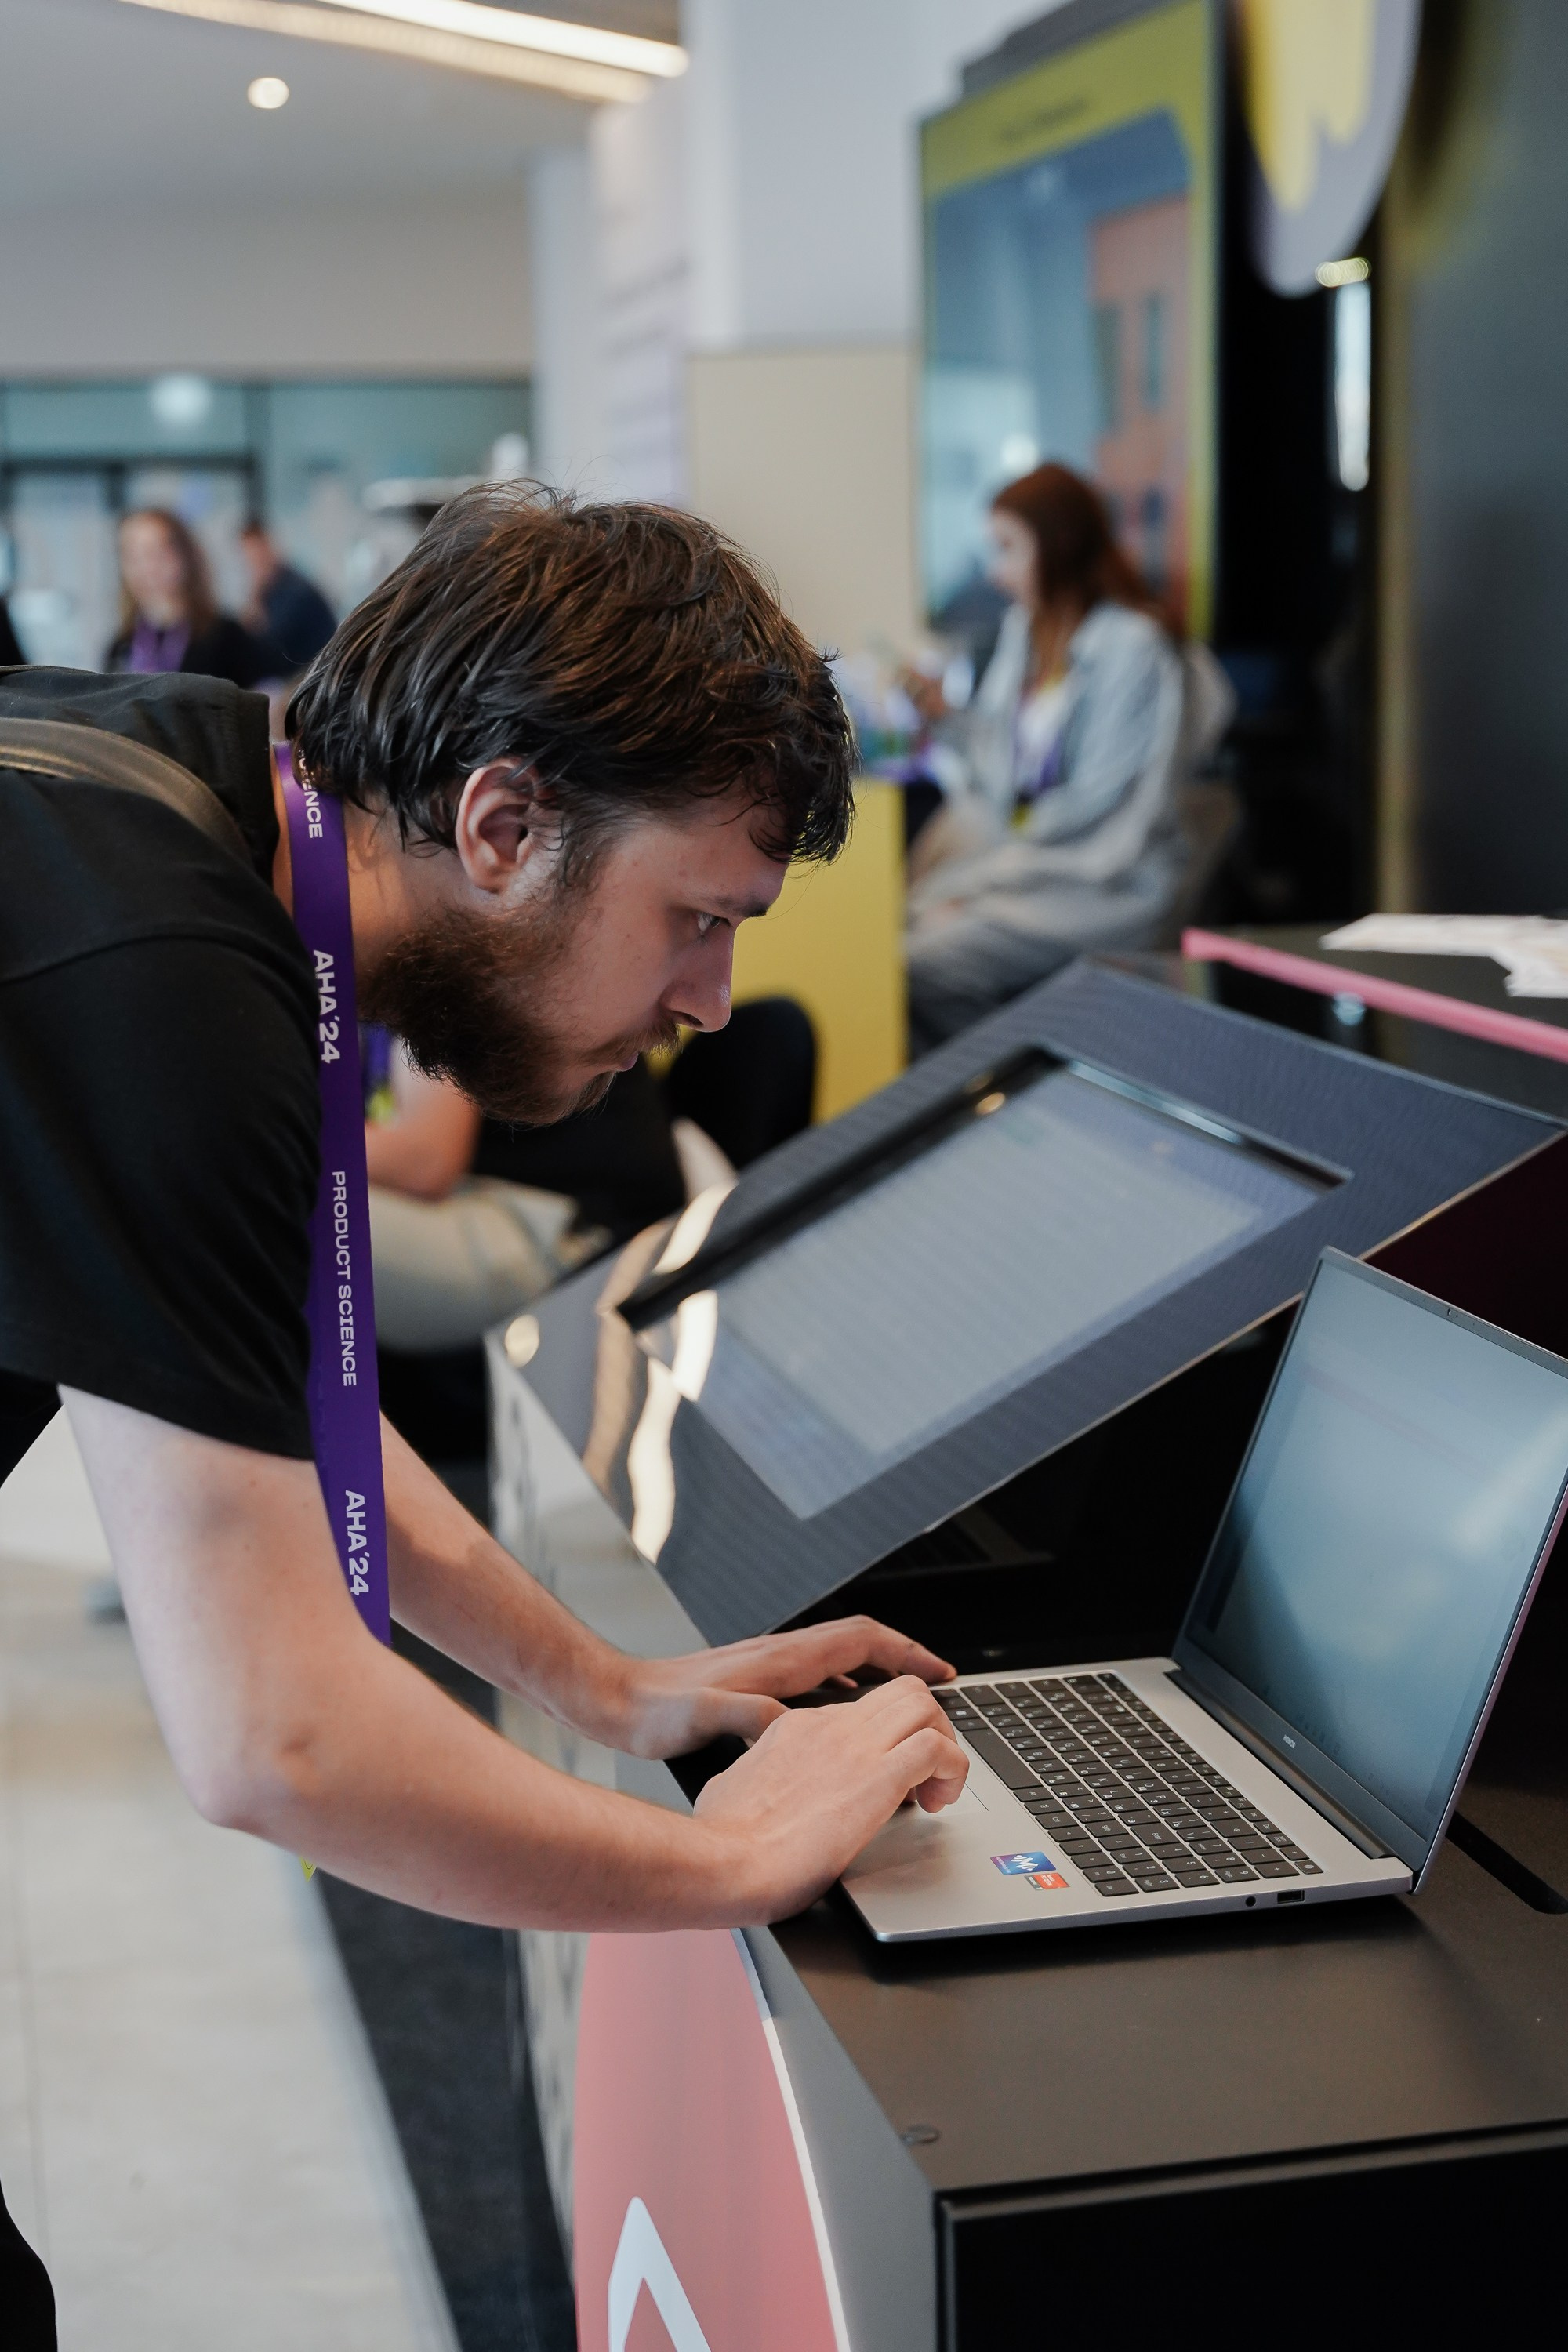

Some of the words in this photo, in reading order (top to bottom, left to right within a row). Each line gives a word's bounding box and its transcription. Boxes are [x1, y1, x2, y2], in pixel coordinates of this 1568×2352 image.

[299, 750, 323, 839] ENCE
[332, 1171, 351, 1280] PRODUCT
[338, 1284, 357, 1387] SCIENCE
